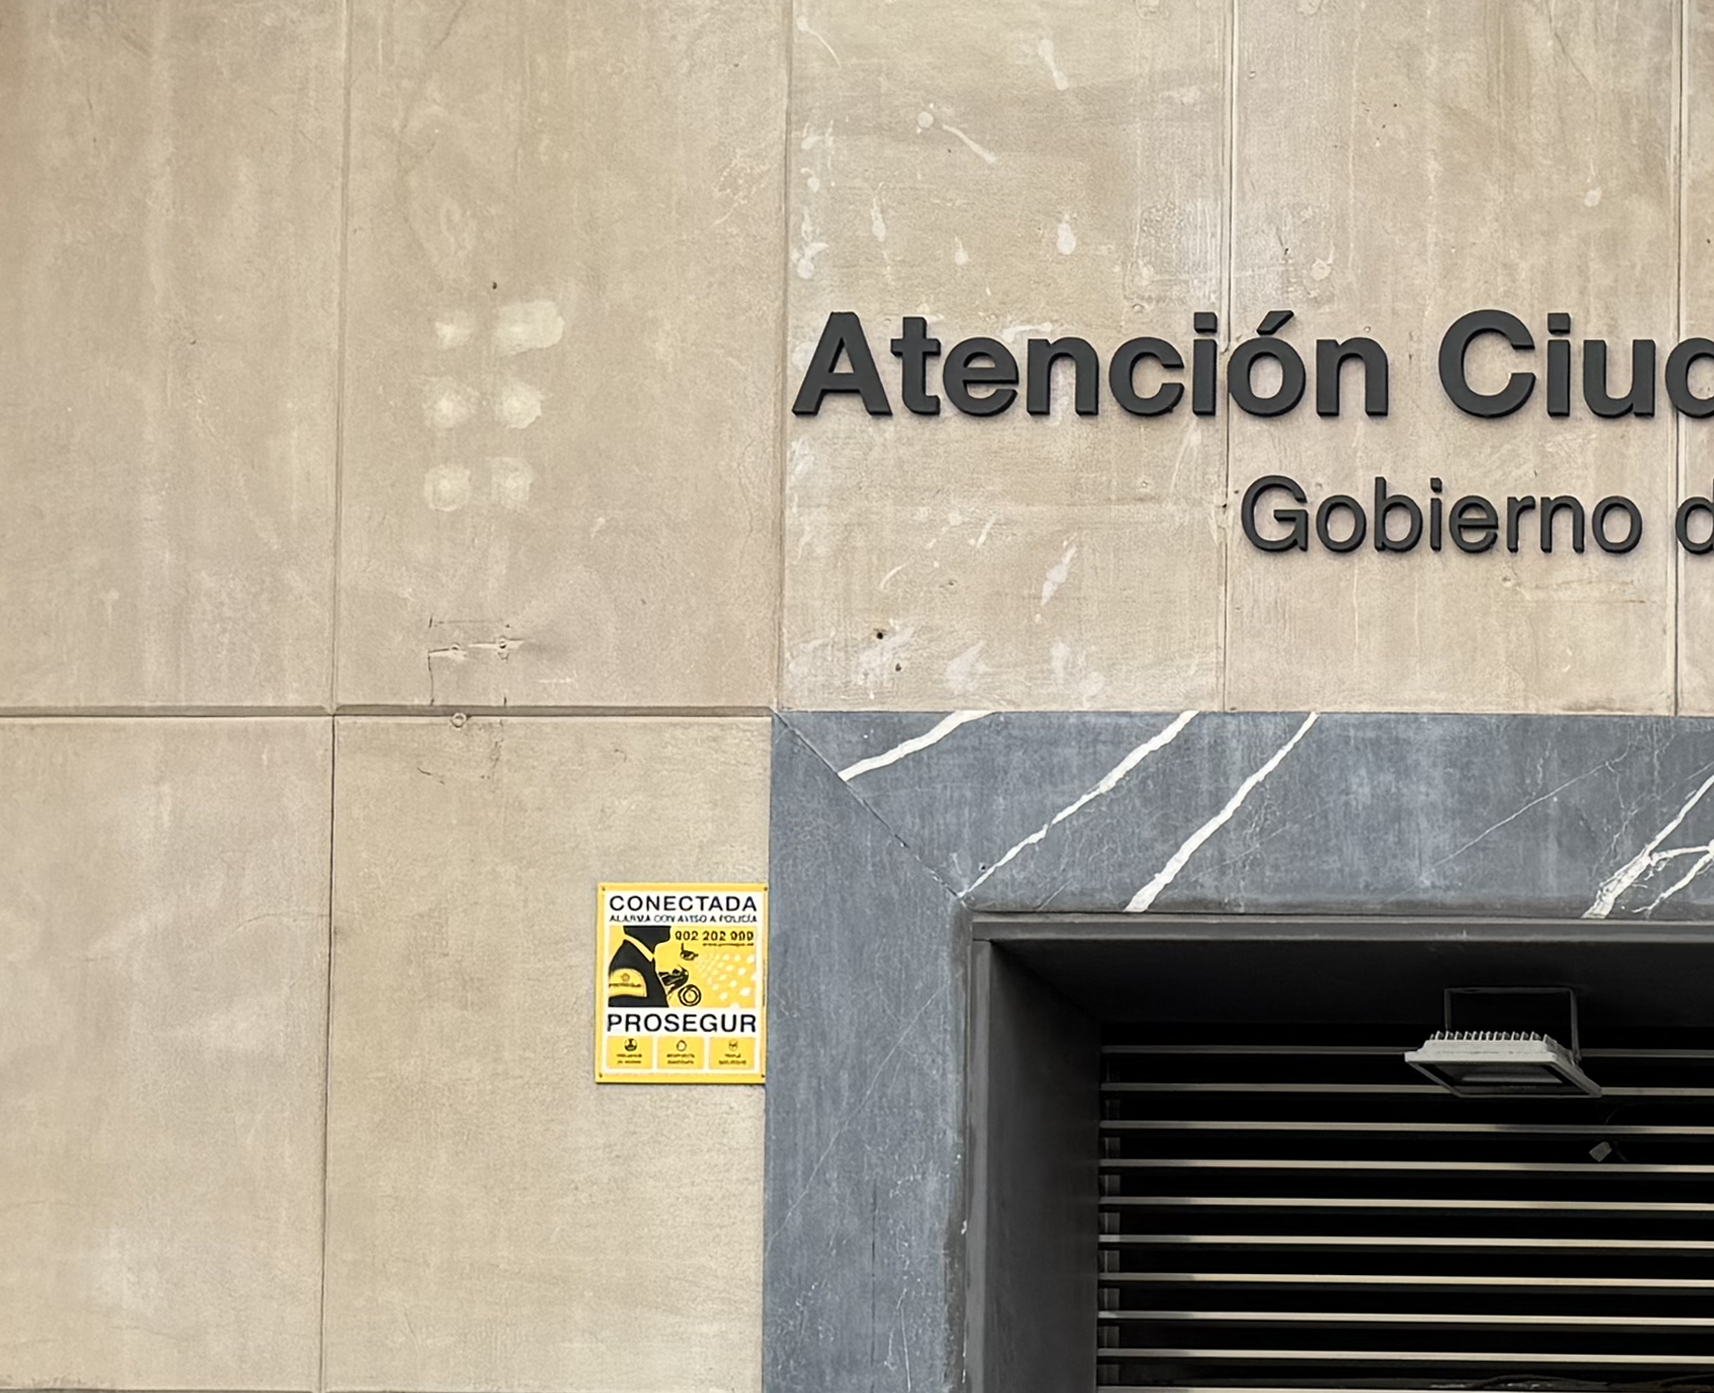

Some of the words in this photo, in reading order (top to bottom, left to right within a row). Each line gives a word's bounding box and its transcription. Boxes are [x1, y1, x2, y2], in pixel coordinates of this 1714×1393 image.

[794, 311, 1389, 416] Atención
[1242, 476, 1642, 554] Gobierno
[610, 896, 756, 911] CONECTADA
[703, 931, 726, 941] 202
[607, 1014, 756, 1032] PROSEGUR
